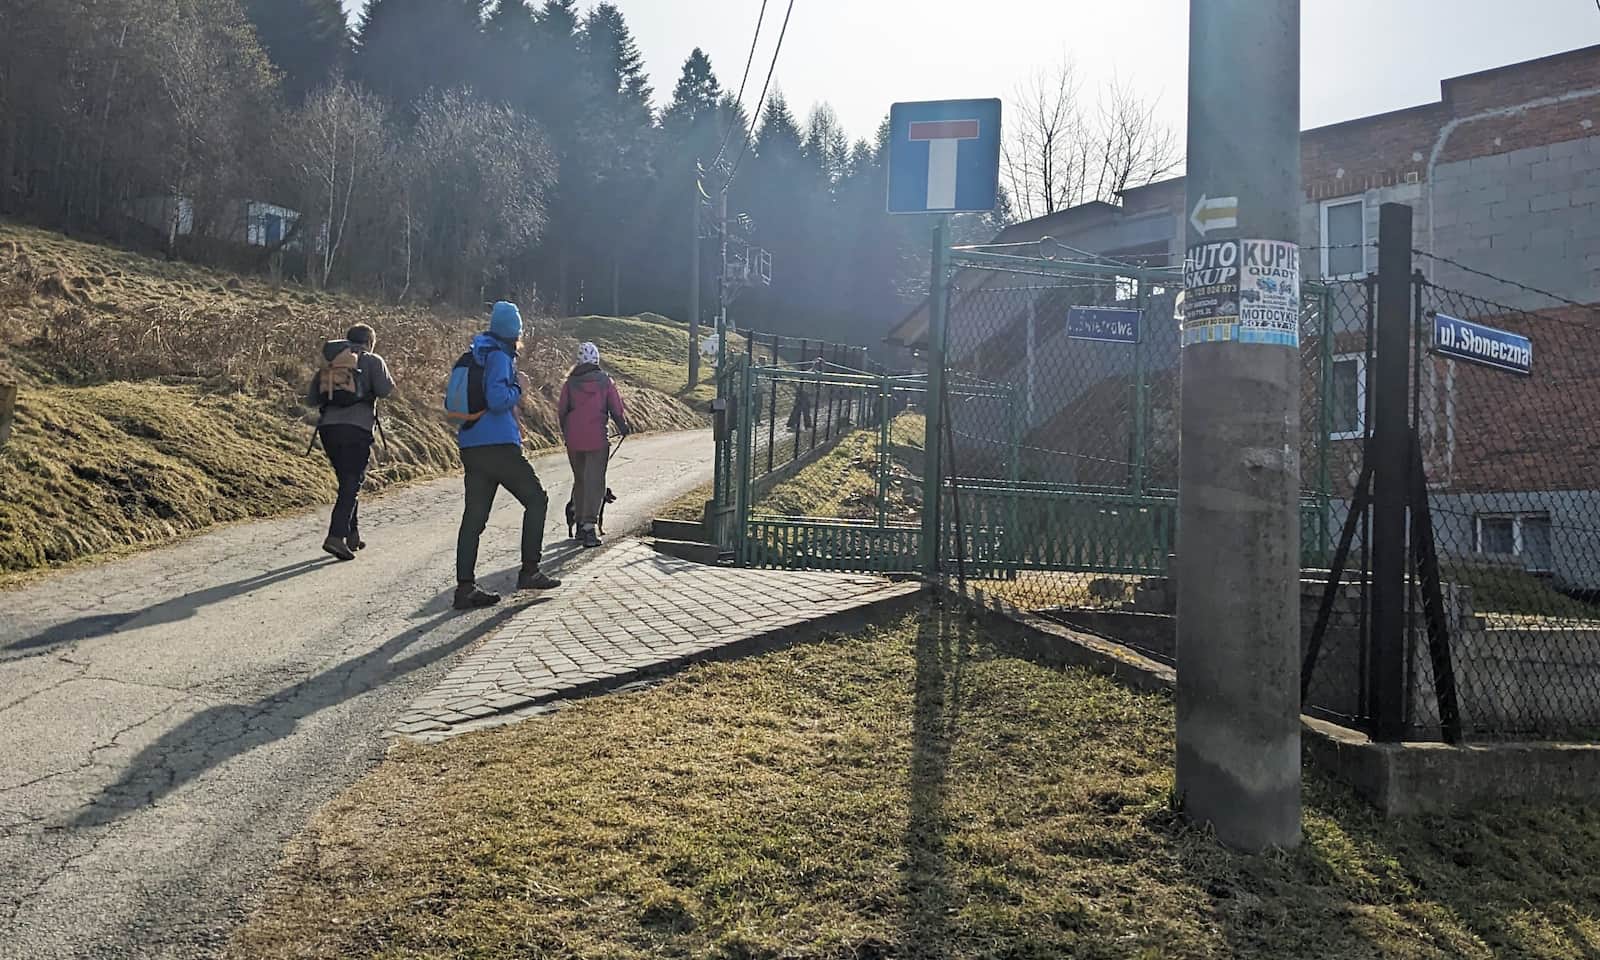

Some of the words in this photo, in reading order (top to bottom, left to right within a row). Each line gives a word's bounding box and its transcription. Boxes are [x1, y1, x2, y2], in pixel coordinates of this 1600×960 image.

[1184, 242, 1237, 274] AUTO
[1185, 267, 1237, 289] SKUP
[1249, 267, 1295, 279] QUADY
[1241, 309, 1297, 323] MOTOCYKLE
